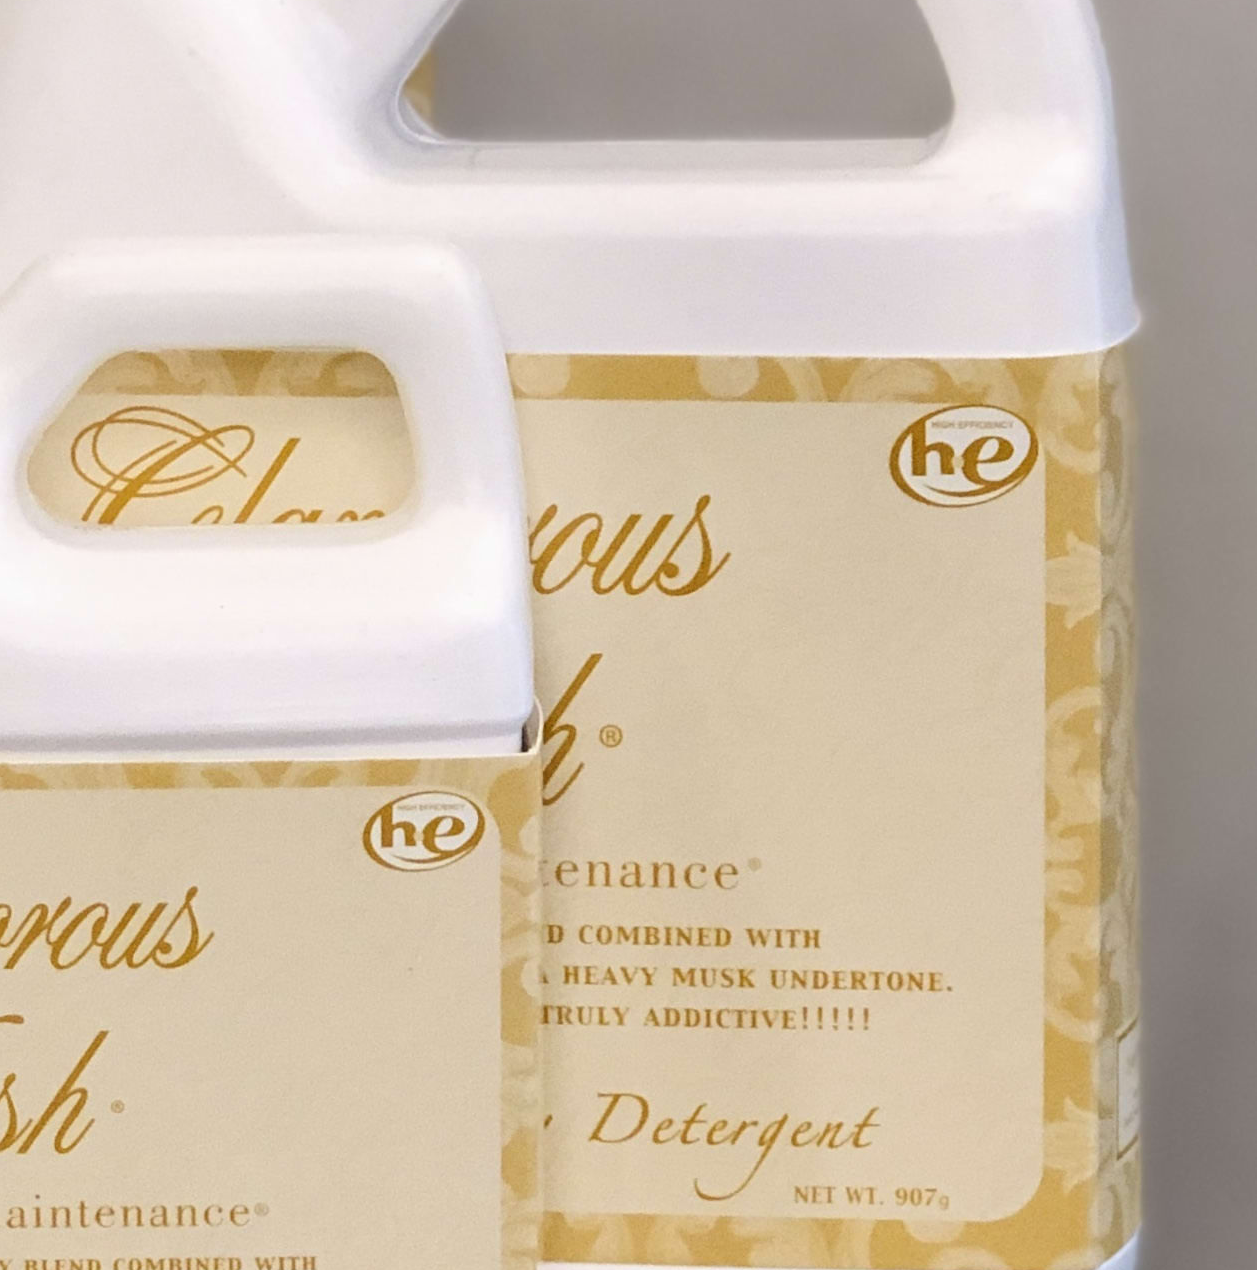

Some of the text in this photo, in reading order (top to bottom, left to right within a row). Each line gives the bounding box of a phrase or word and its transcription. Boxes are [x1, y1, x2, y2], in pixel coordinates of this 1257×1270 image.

[578, 925, 732, 947] COMBINED
[745, 928, 820, 949] WITH
[562, 965, 657, 988] HEAVY
[672, 967, 755, 989] MUSK
[770, 969, 953, 992] UNDERTONE.
[643, 1006, 870, 1032] ADDICTIVE!!!!!
[588, 1092, 880, 1205] Detergent
[794, 1185, 949, 1210] NET WT. 907g
